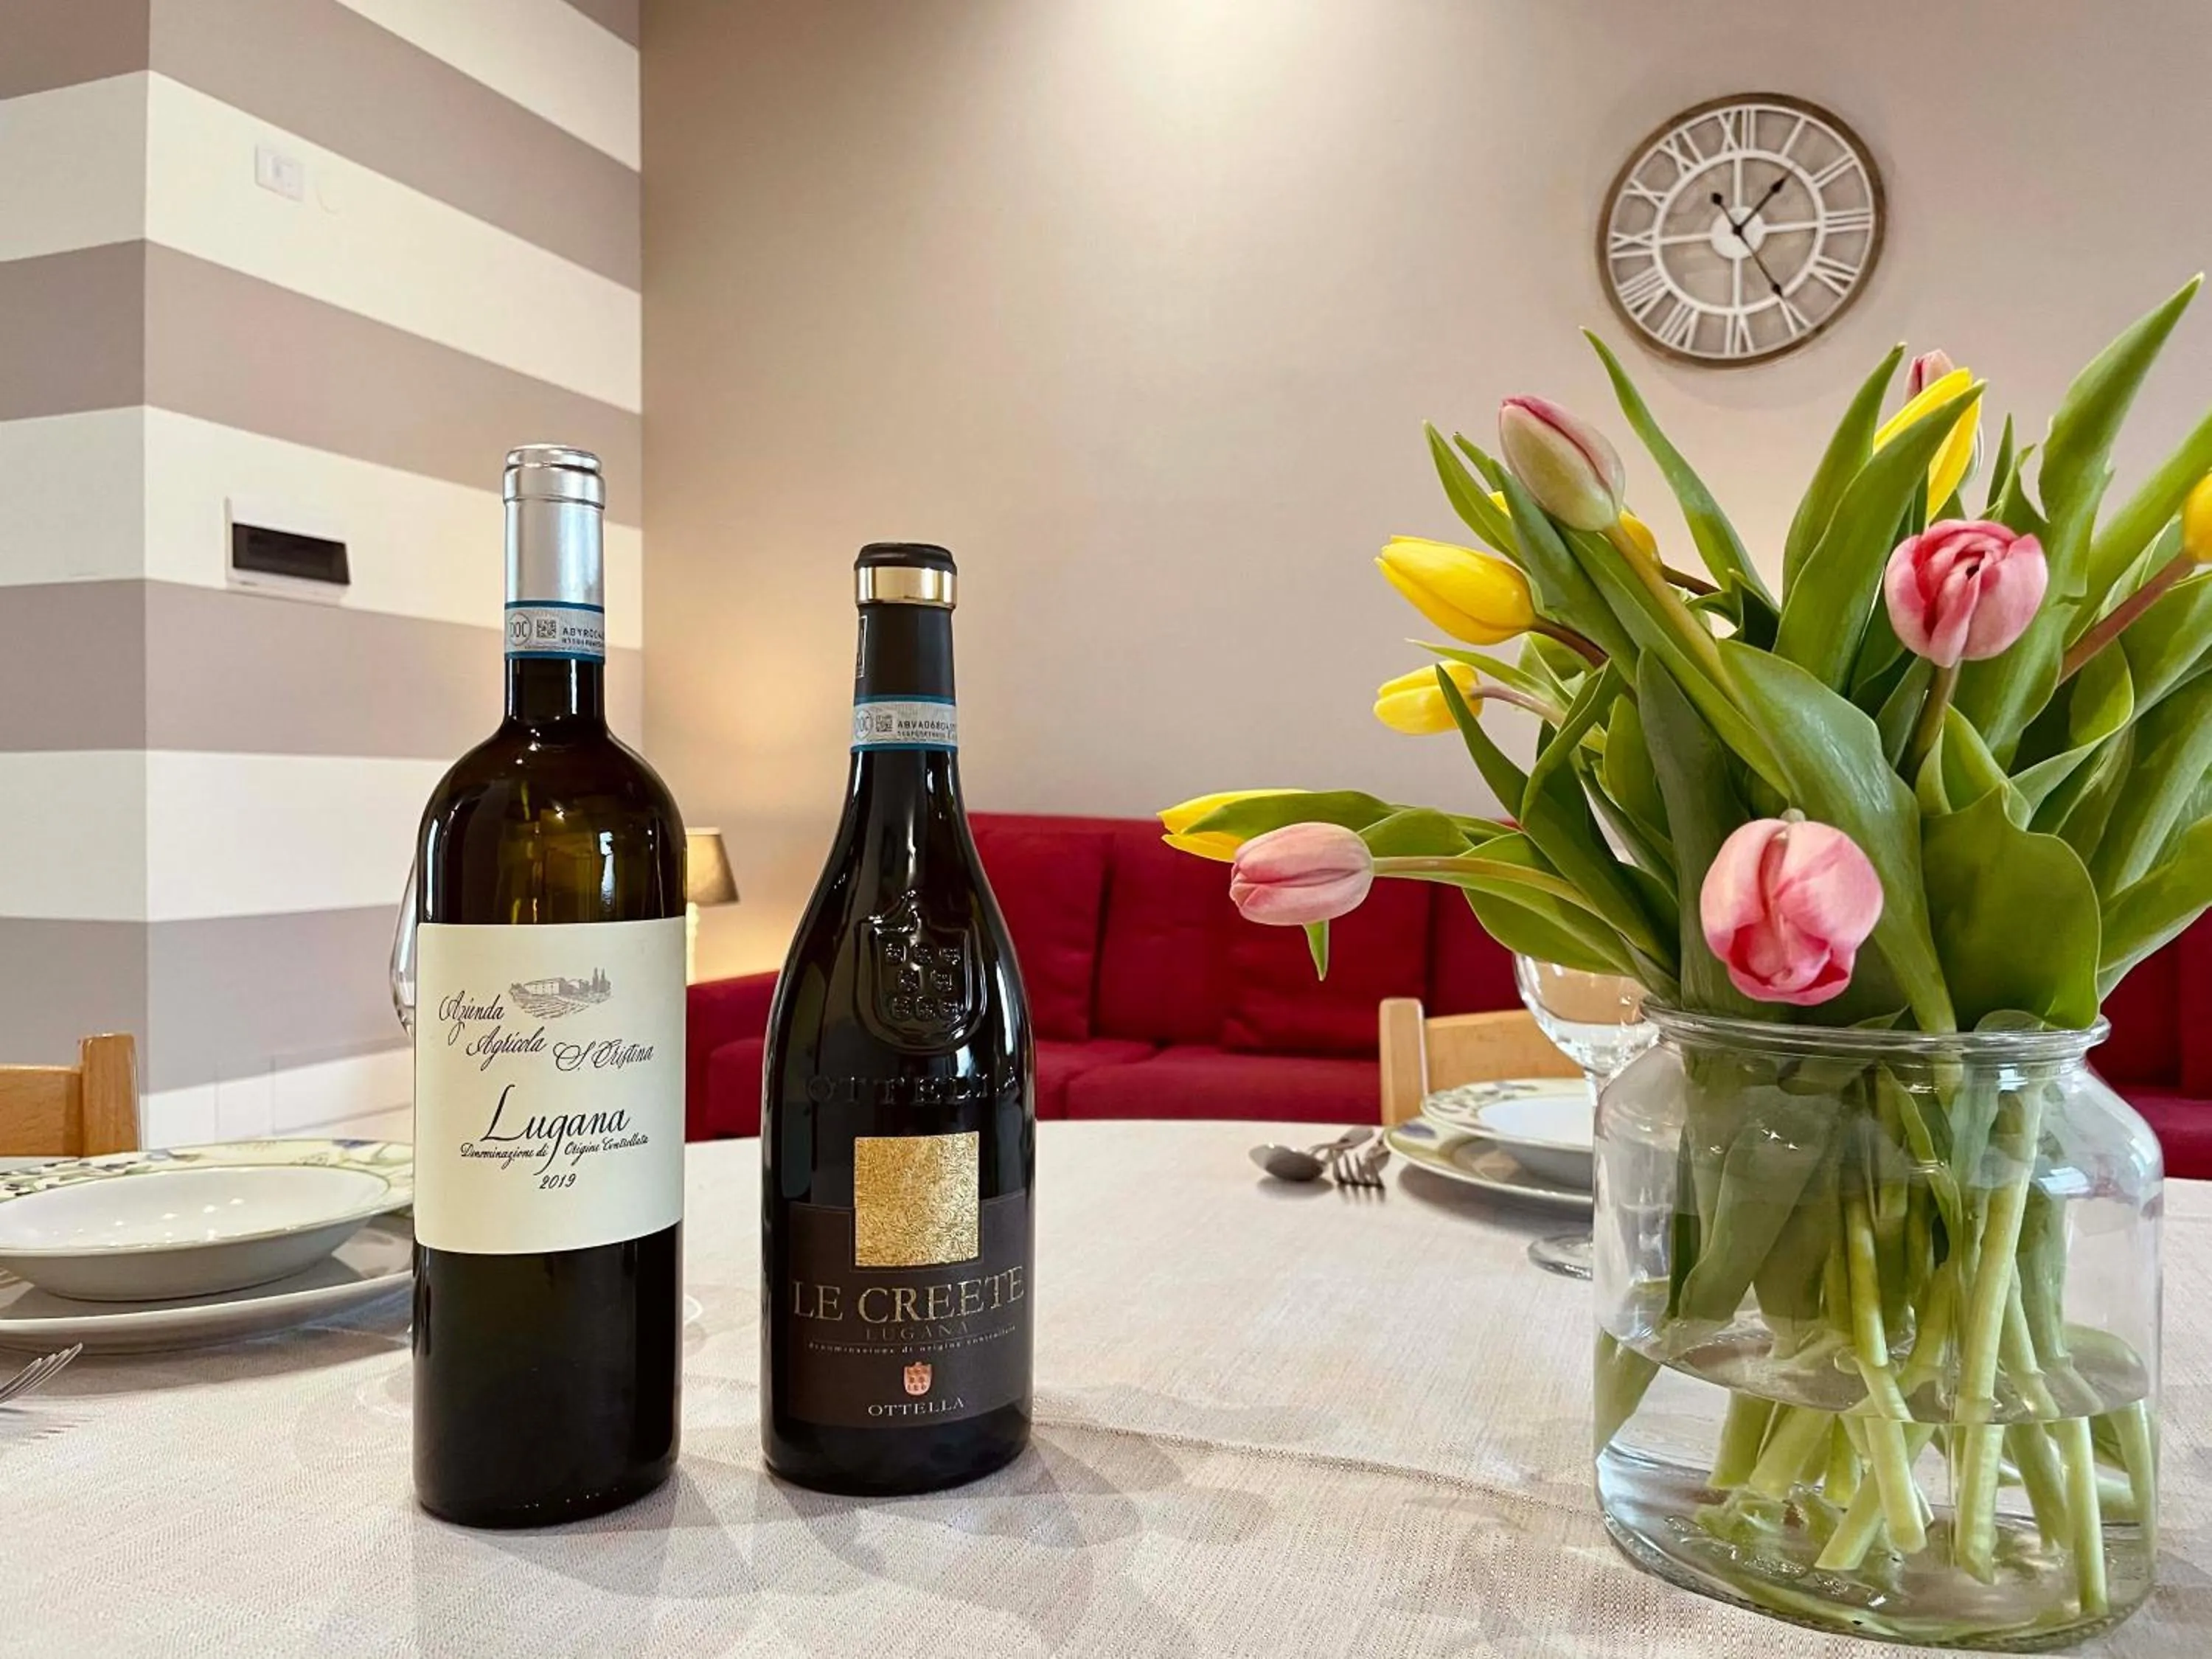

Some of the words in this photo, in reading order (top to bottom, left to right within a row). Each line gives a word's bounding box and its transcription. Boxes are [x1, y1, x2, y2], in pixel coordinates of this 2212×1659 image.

[1719, 109, 1756, 152] XII
[1657, 129, 1704, 176] XI
[1624, 179, 1669, 209] X
[439, 990, 504, 1046] Azienda
[465, 1026, 547, 1071] Agricola
[591, 1039, 654, 1069] Cristina
[480, 1084, 630, 1175] Lugana
[460, 1143, 534, 1169] Denominazione
[535, 1143, 548, 1157] di
[564, 1141, 600, 1166] Origine
[539, 1173, 577, 1189] 2019
[793, 1281, 844, 1321] LE
[858, 1266, 1025, 1324] CREETE
[866, 1321, 969, 1341] LUGANA
[868, 1397, 965, 1416] OTTELLA
